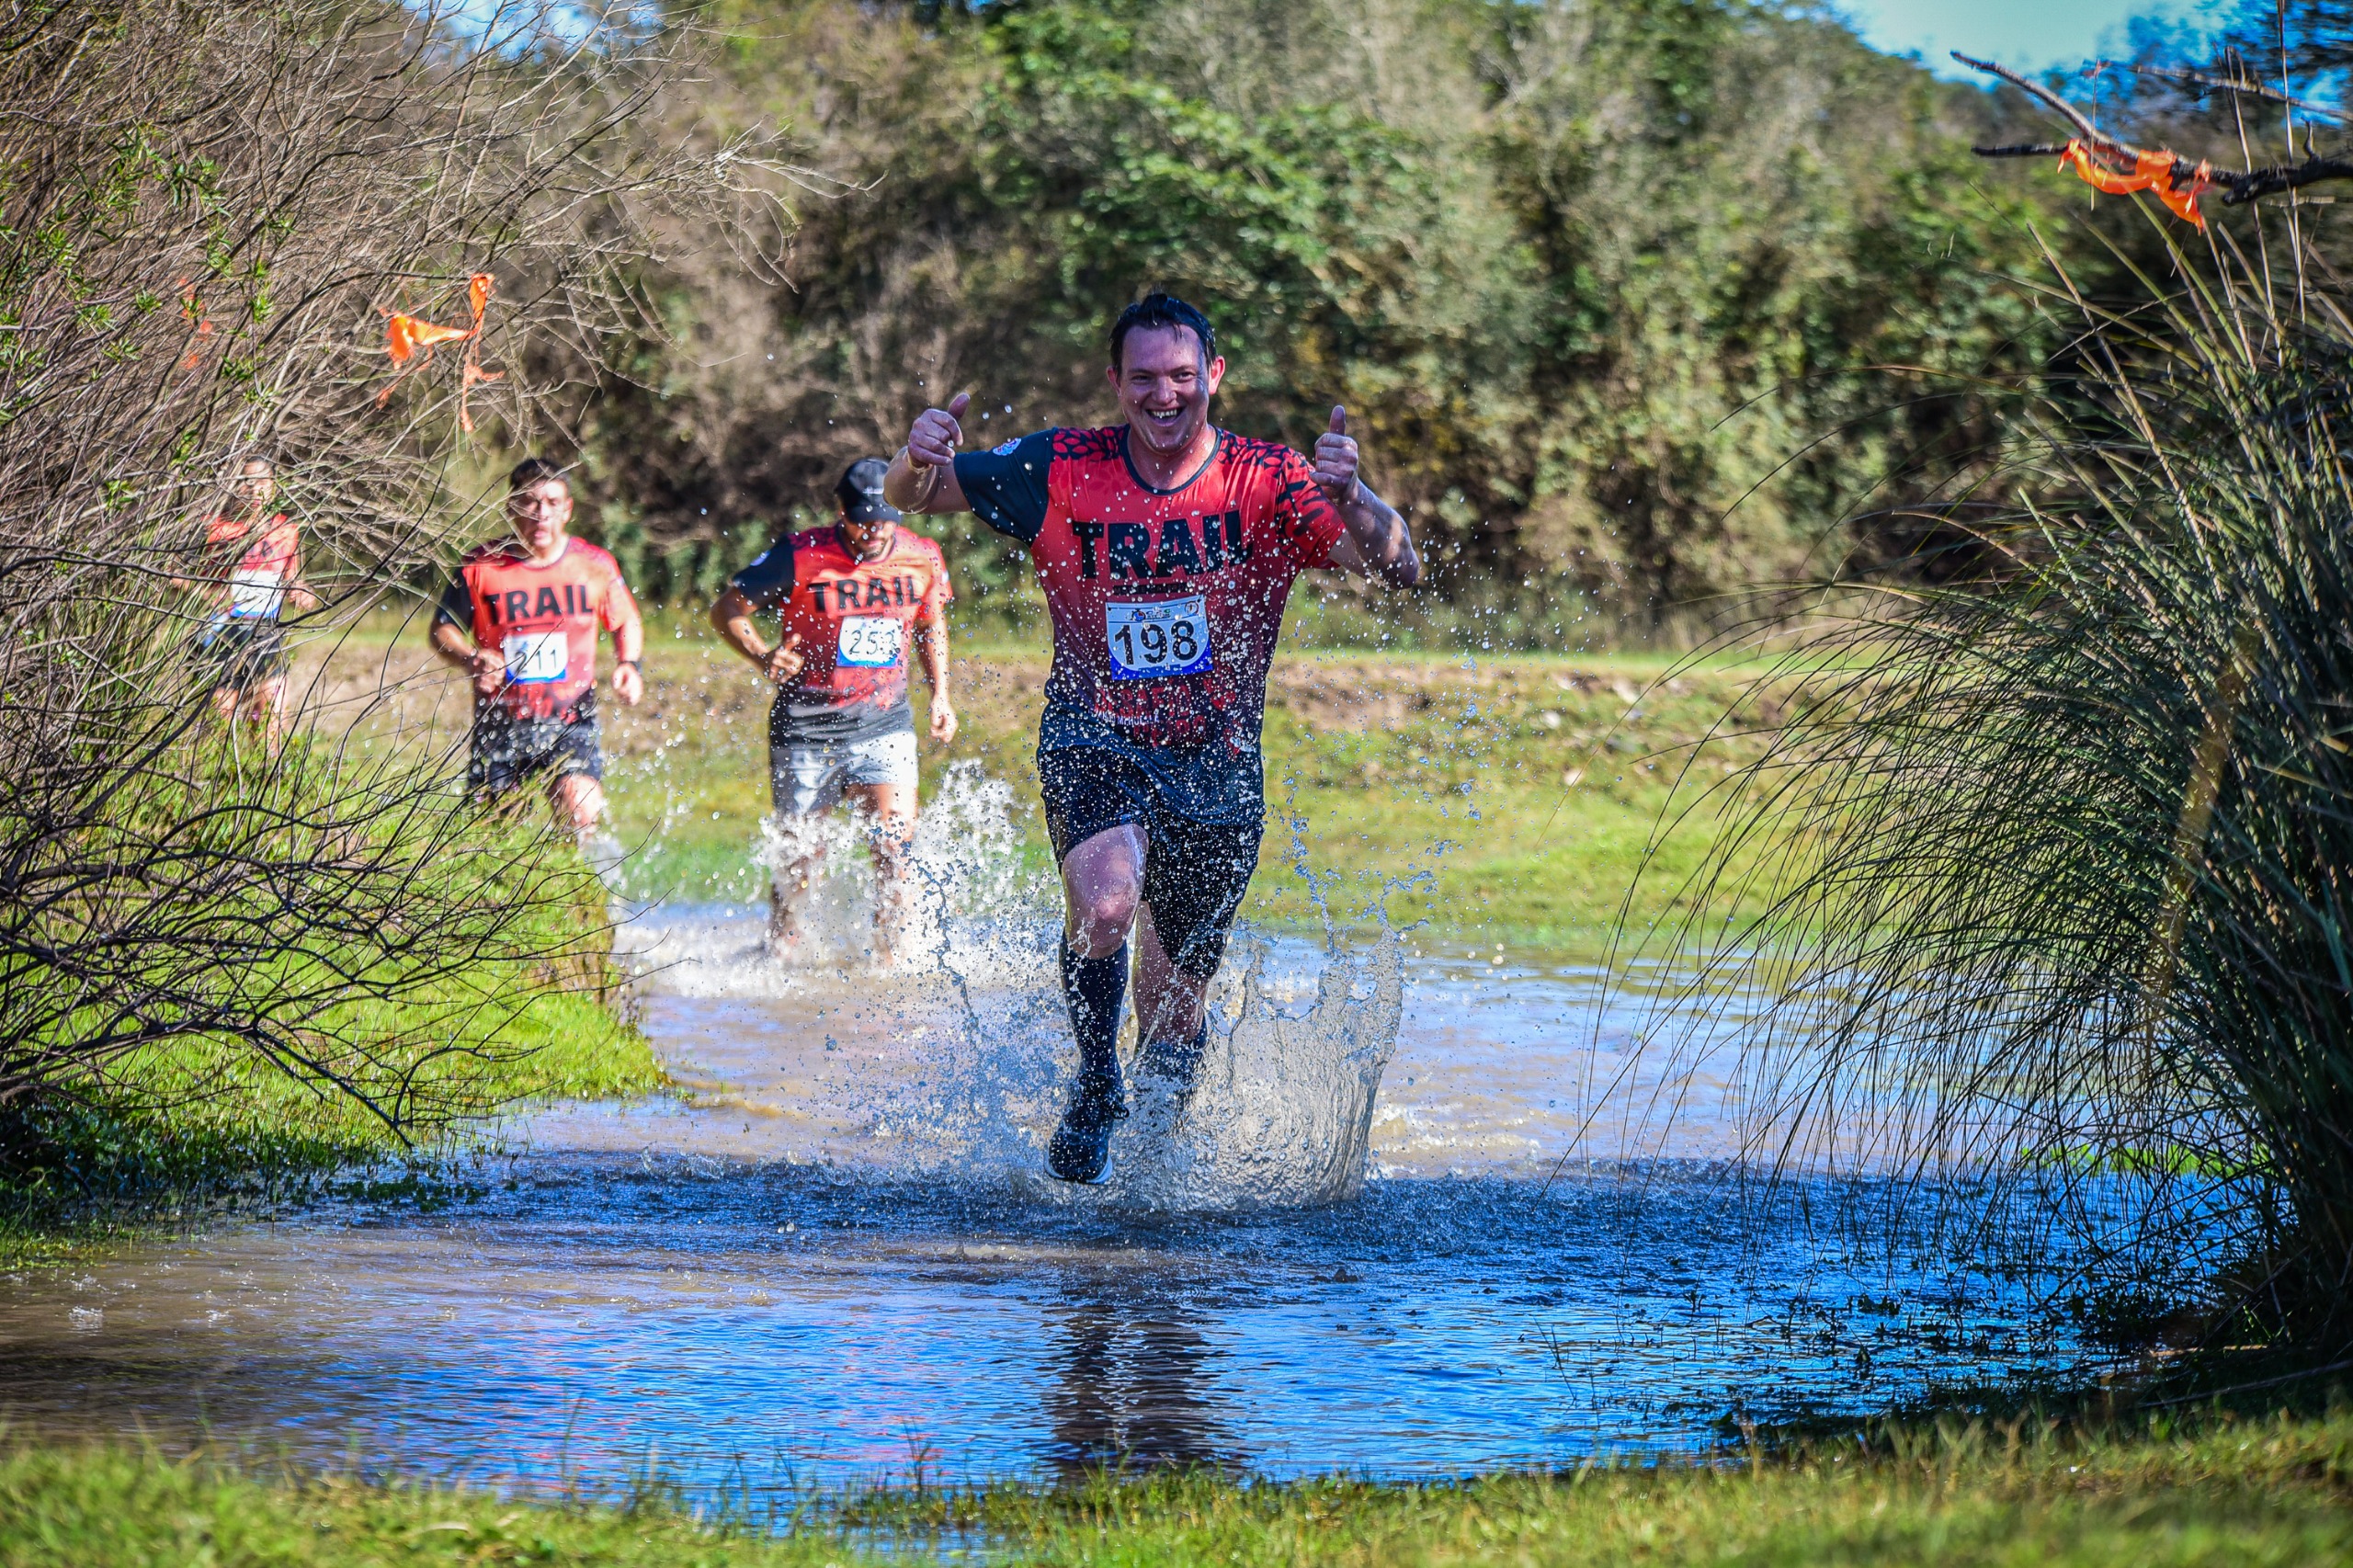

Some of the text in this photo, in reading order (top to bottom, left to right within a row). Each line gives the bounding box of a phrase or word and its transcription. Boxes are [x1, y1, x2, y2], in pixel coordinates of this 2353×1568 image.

[1072, 510, 1254, 579] TRAIL
[484, 585, 594, 626] TRAIL
[808, 575, 920, 613] TRAIL
[515, 649, 557, 674] 211
[1114, 619, 1198, 665] 198
